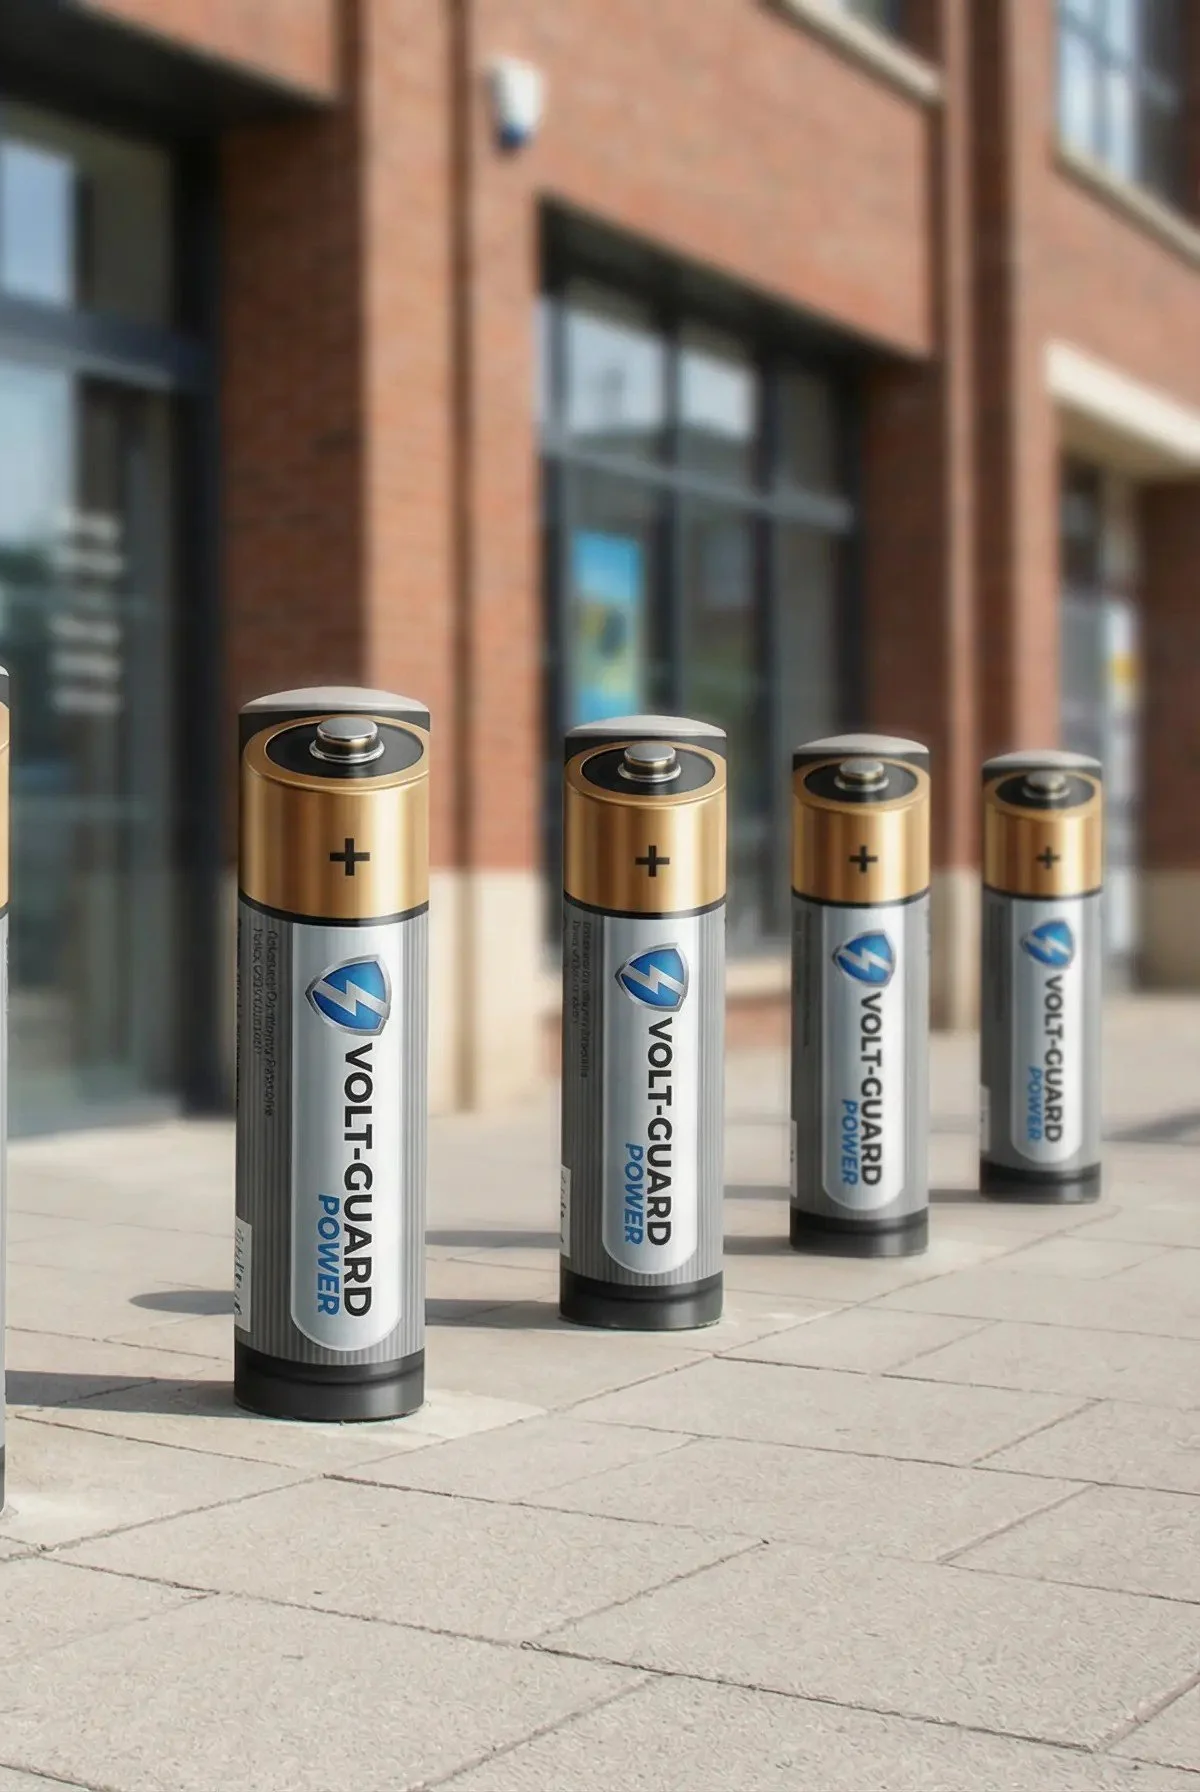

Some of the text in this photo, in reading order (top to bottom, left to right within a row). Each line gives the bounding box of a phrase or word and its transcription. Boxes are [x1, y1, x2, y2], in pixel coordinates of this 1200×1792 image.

[646, 1016, 674, 1246] VOLT-GUARD
[860, 991, 883, 1187] VOLT-GUARD
[1027, 1066, 1043, 1142] POWER
[1044, 974, 1063, 1144] VOLT-GUARD
[343, 1042, 374, 1317] VOLT-GUARD
[623, 1142, 645, 1246] POWER
[841, 1099, 859, 1185] POWER
[316, 1194, 341, 1316] POWER
